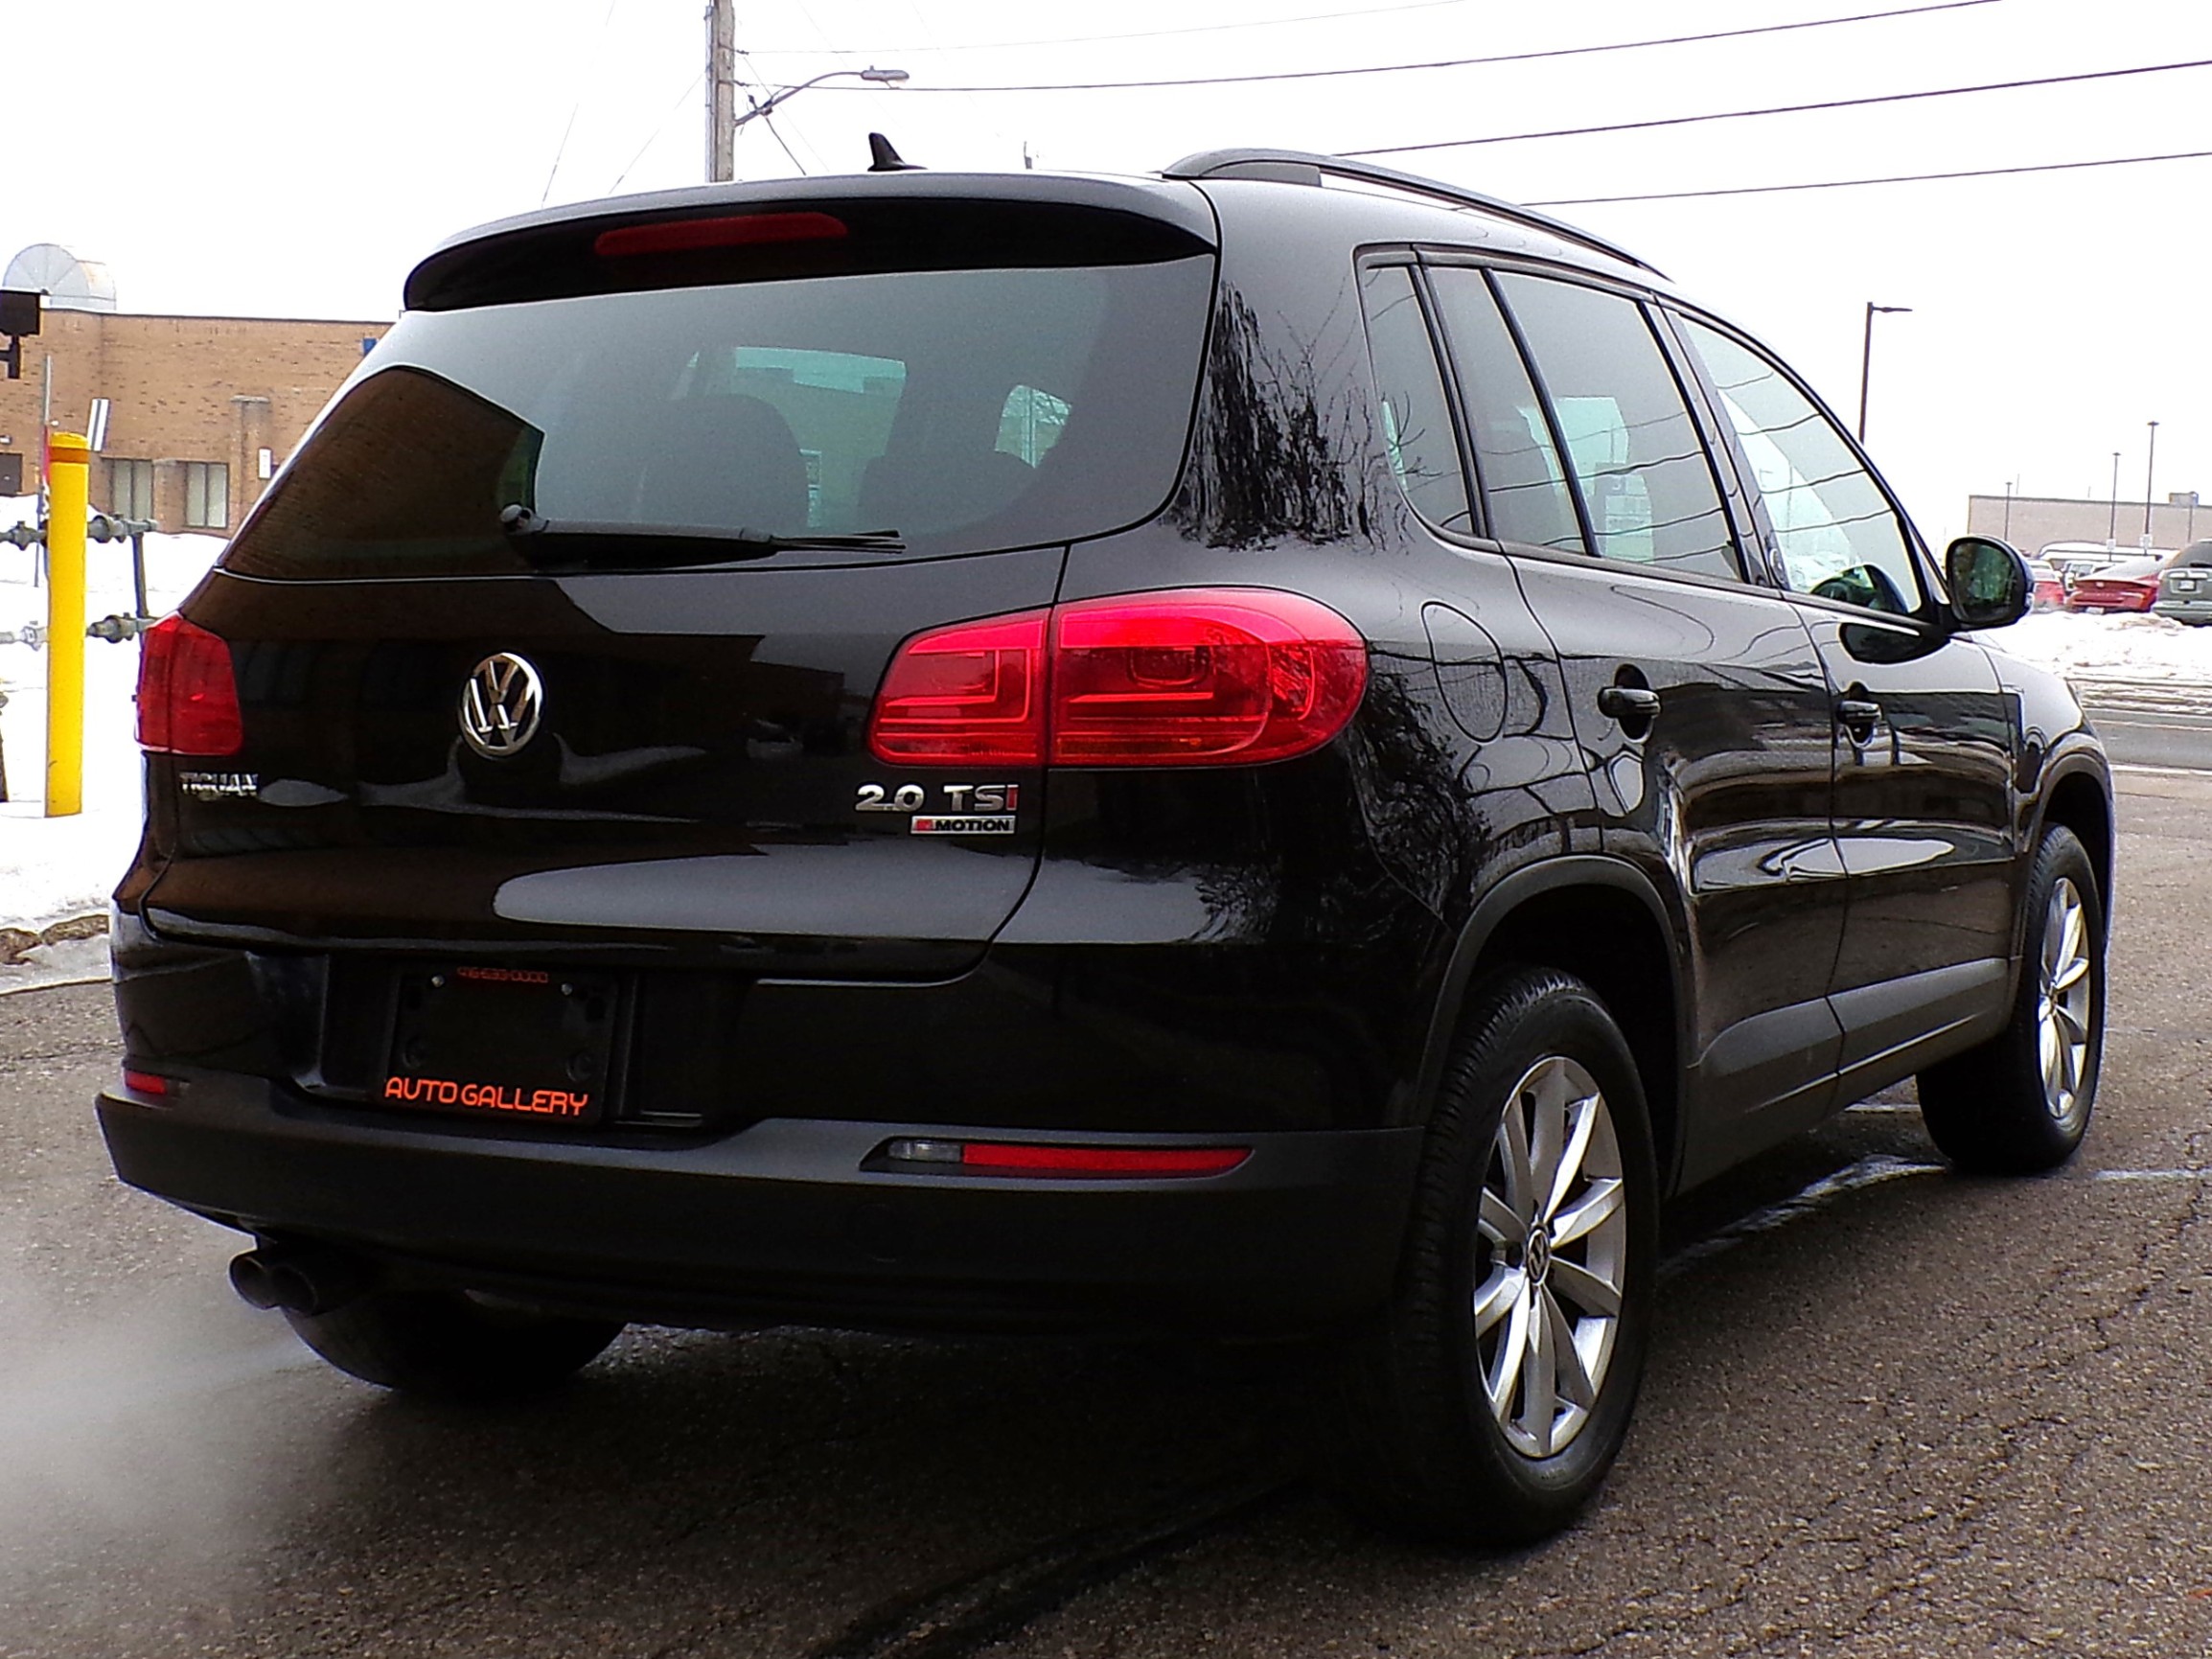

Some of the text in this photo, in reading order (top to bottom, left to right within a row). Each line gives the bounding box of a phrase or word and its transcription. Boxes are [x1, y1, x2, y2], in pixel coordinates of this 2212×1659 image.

[855, 784, 1019, 812] 2.0 TSI
[385, 1077, 588, 1116] AUTO GALLERY
